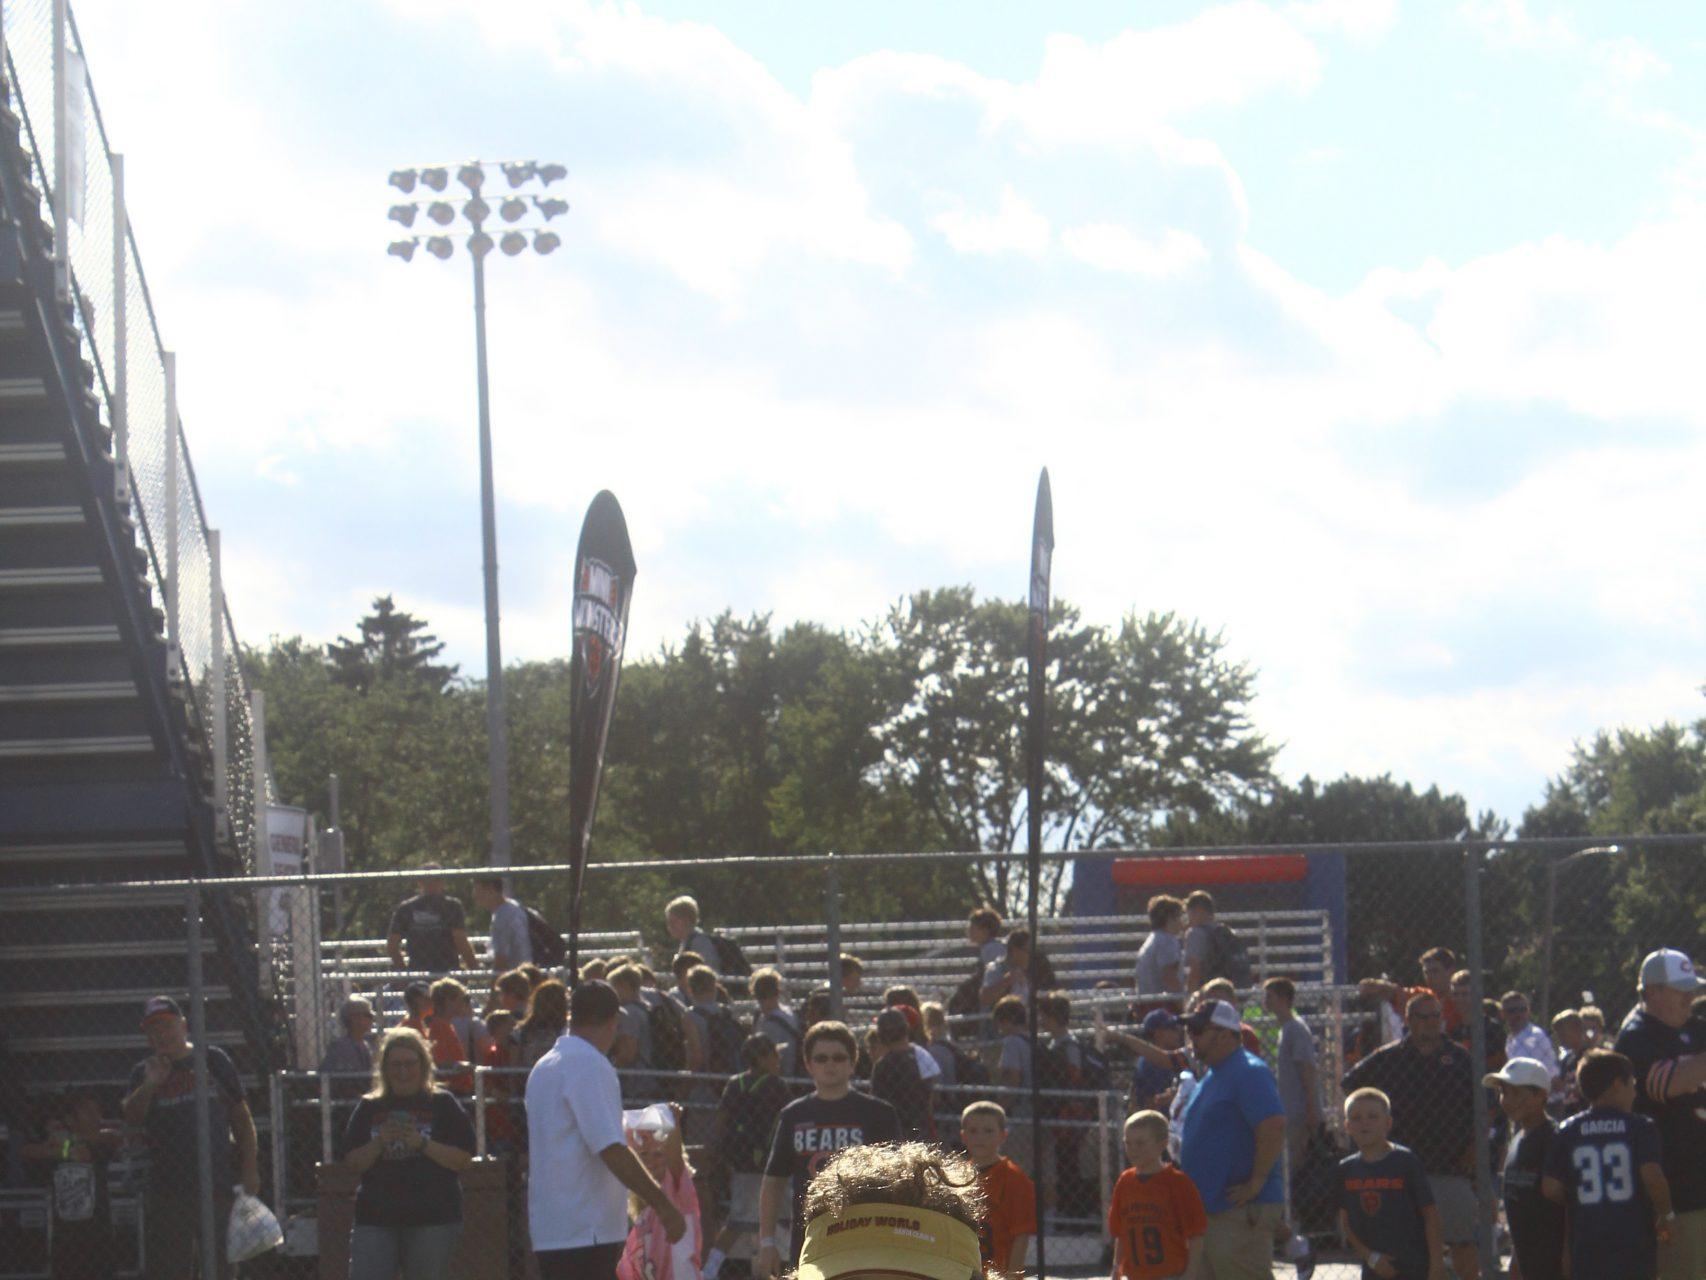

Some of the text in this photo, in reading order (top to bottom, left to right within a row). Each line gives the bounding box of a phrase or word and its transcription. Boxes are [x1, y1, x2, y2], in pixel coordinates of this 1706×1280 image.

[793, 1127, 864, 1152] BEARS
[1580, 1119, 1626, 1136] GARCIA
[1573, 1142, 1634, 1204] 33
[874, 1216, 921, 1231] WORLD
[1128, 1226, 1165, 1265] 19
